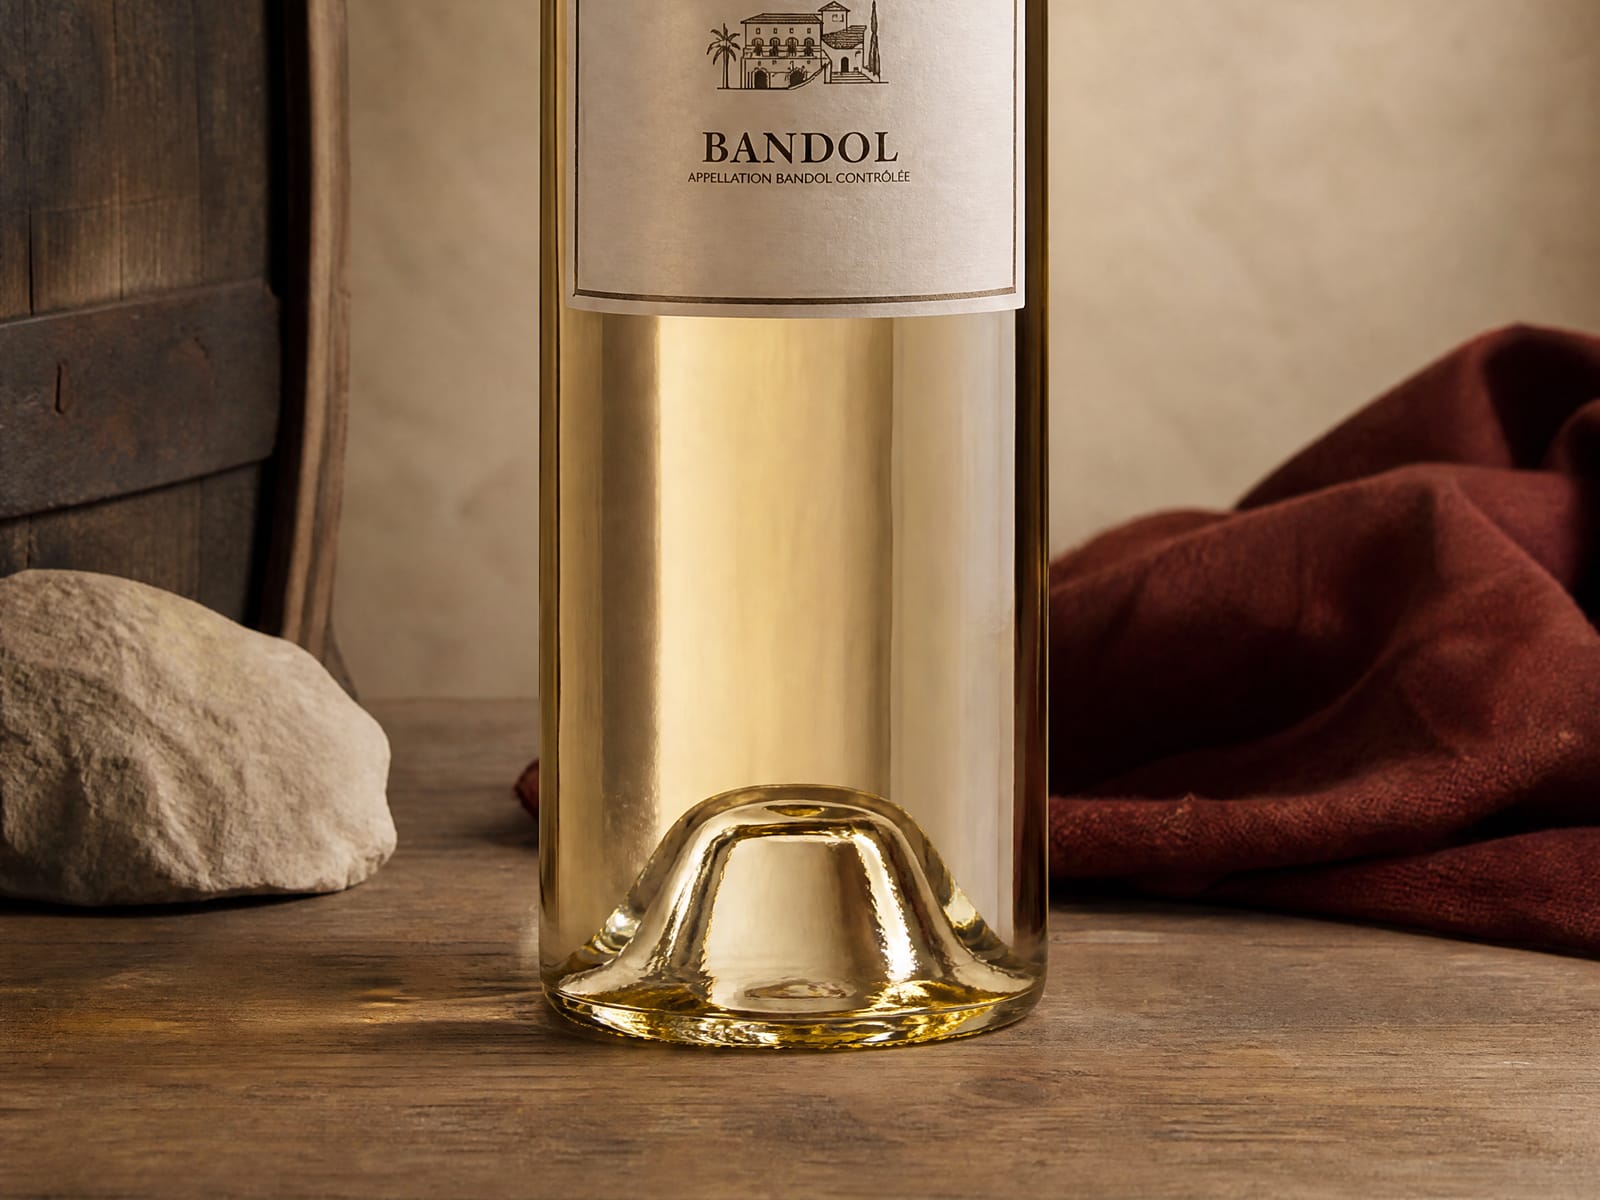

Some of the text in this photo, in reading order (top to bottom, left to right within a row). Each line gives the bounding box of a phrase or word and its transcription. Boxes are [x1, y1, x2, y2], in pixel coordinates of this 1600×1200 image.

[702, 131, 899, 164] BANDOL
[688, 169, 911, 184] APPELLATION BANDOL CONTRÔLÉE
